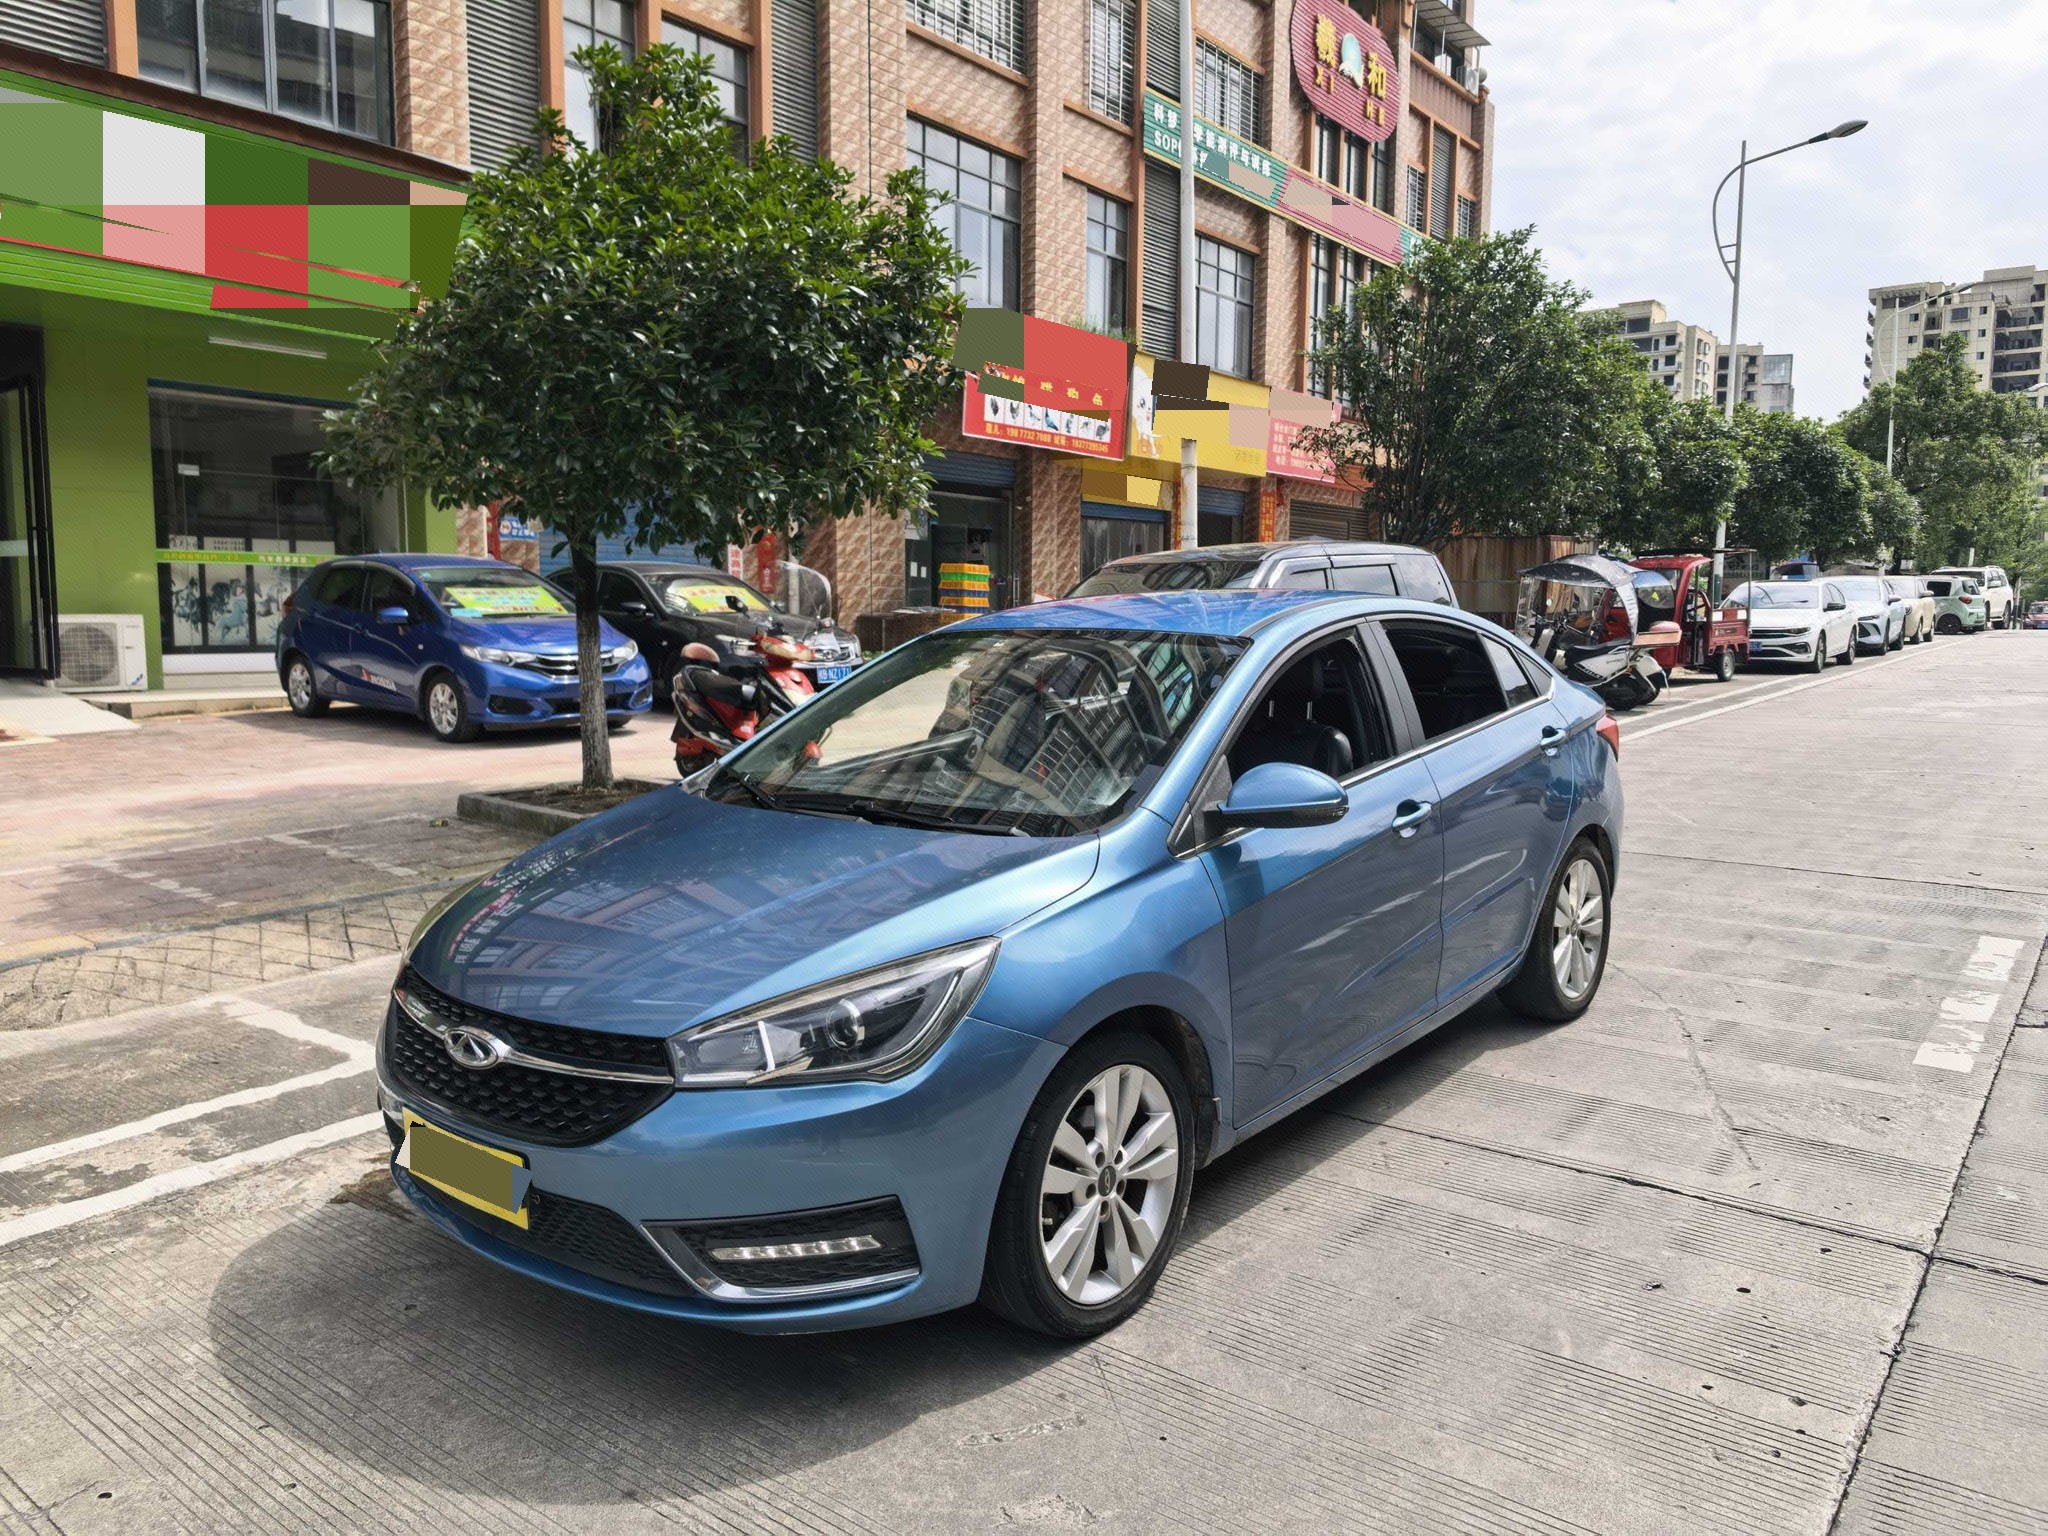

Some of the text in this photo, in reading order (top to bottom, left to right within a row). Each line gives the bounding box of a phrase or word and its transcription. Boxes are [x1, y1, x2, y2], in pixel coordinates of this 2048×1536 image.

[1153, 102, 1271, 177] 科梦学能测评与训练
